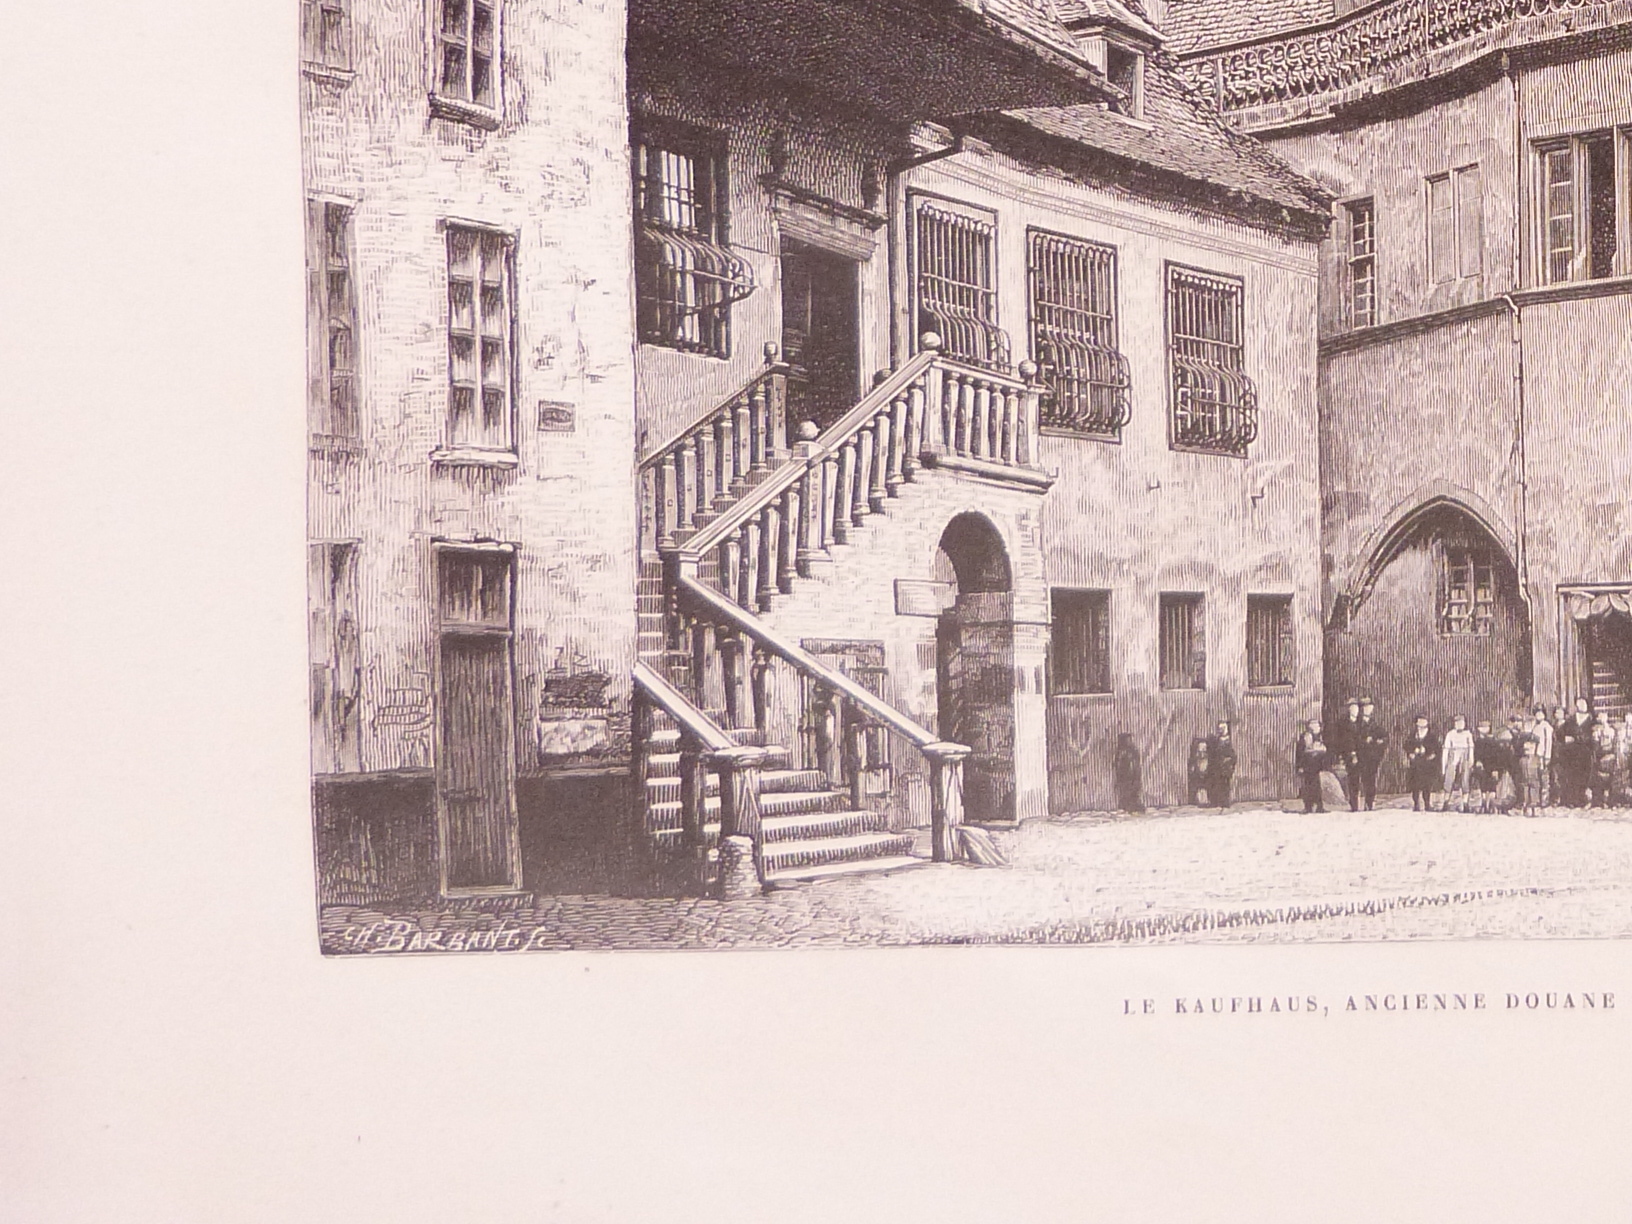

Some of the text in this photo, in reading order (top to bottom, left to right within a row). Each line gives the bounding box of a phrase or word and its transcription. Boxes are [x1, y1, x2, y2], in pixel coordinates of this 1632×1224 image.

[1123, 998, 1156, 1016] LE
[1175, 994, 1329, 1018] KAUFHAUS,
[1345, 993, 1487, 1012] ANCIENNE
[1505, 992, 1615, 1010] DOUANE
